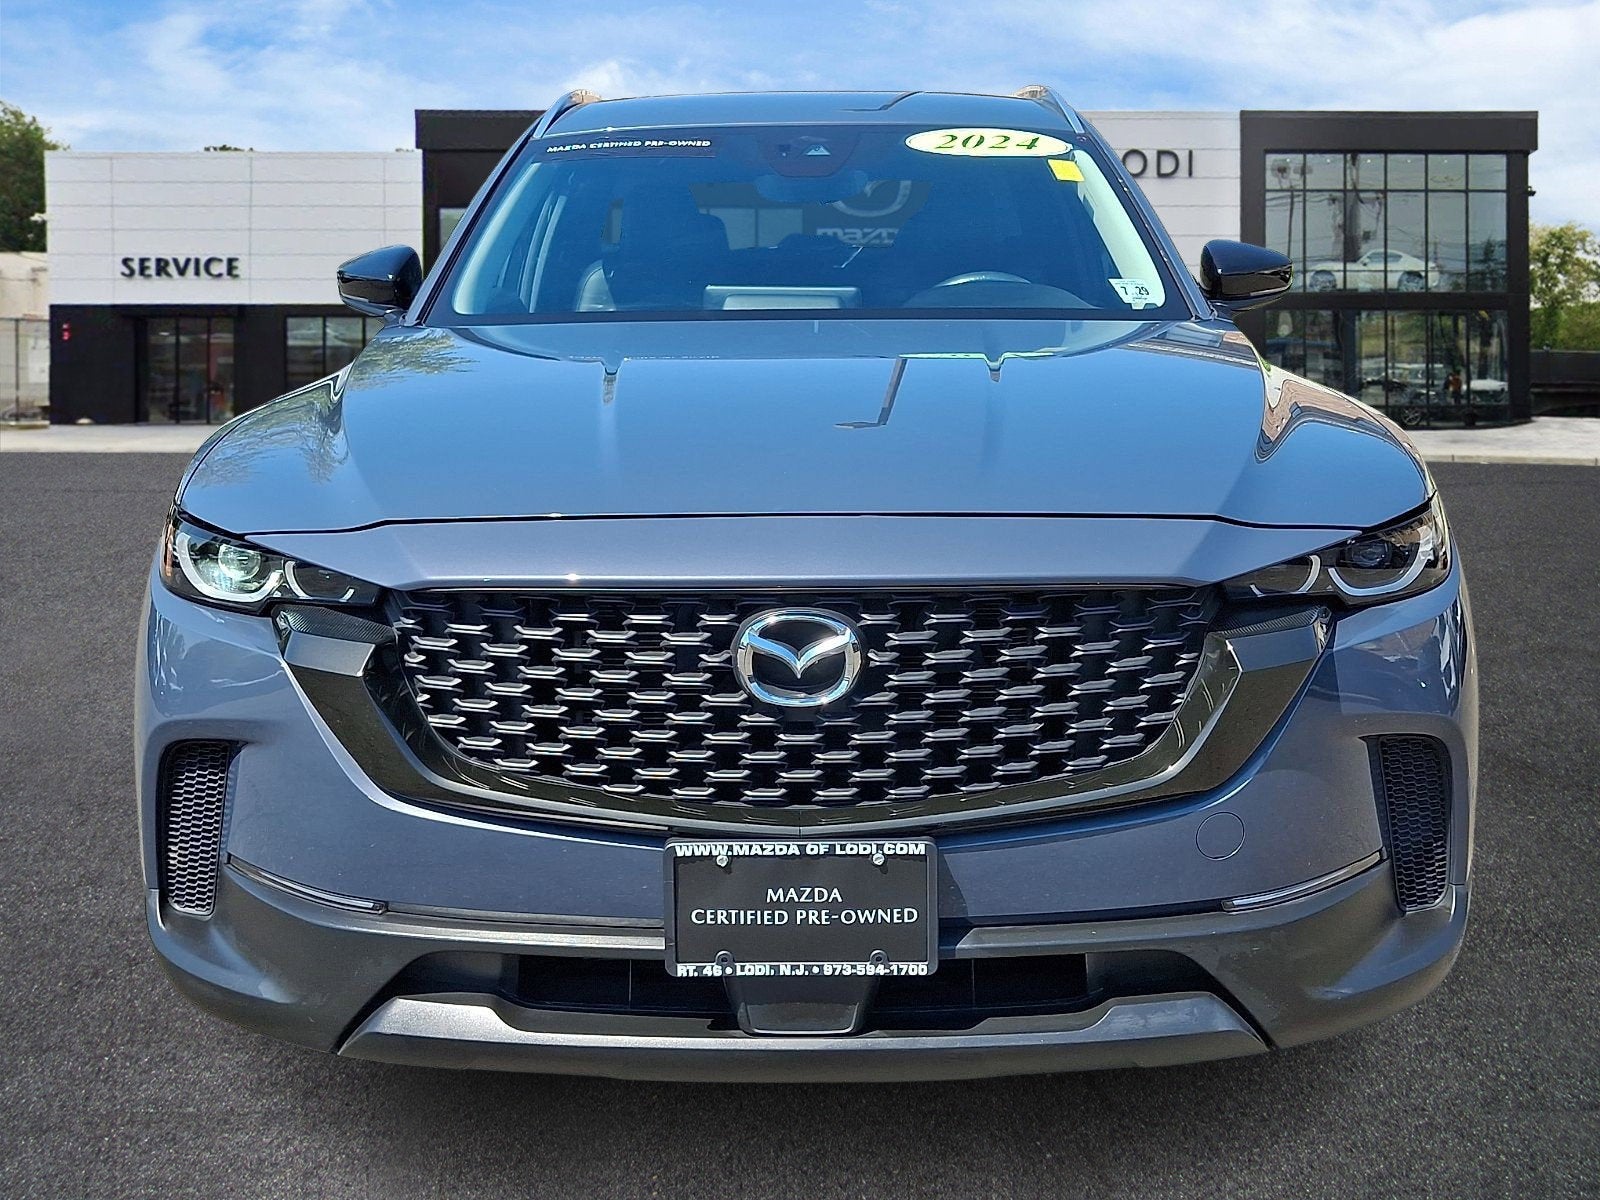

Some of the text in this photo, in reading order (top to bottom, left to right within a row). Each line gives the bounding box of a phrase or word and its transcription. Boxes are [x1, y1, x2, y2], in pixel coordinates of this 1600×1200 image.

[936, 133, 1040, 150] 2024
[1121, 148, 1193, 178] ODI
[120, 256, 241, 278] SERVICE
[805, 844, 830, 856] OF
[766, 887, 843, 903] MAZDA
[690, 907, 919, 925] CERTIFIED PRE-OWNED
[702, 965, 723, 976] 46
